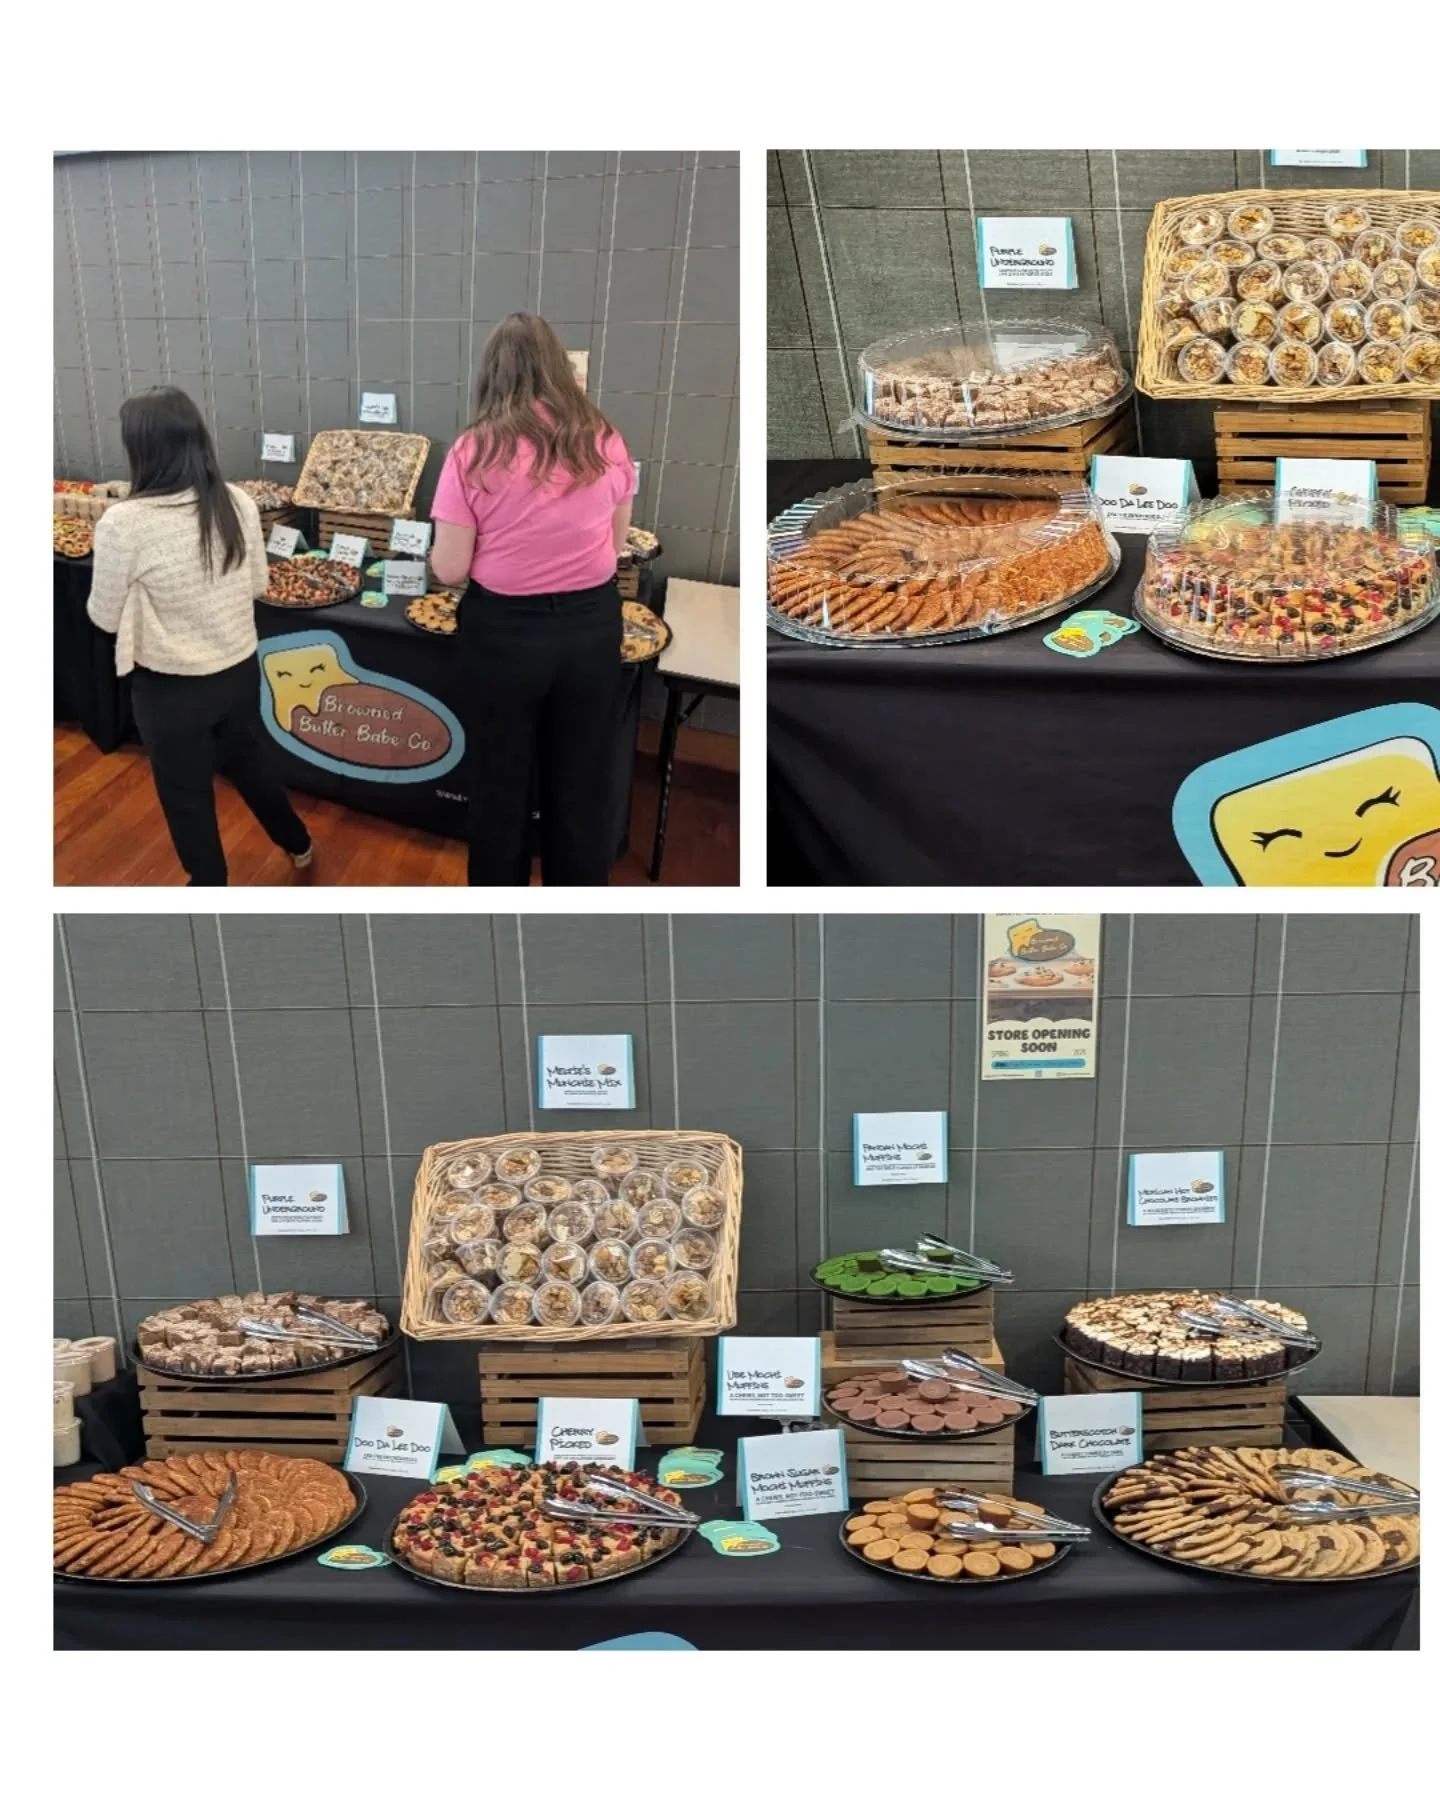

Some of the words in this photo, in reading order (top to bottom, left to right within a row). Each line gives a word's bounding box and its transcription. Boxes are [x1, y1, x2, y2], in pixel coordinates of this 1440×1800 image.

[324, 695, 404, 722] Browned
[300, 715, 346, 738] Butter
[356, 725, 400, 747] Babe
[408, 732, 432, 751] Co
[988, 1030, 1029, 1040] STORE
[1031, 1028, 1091, 1039] OPENING
[1020, 1042, 1057, 1053] SOON
